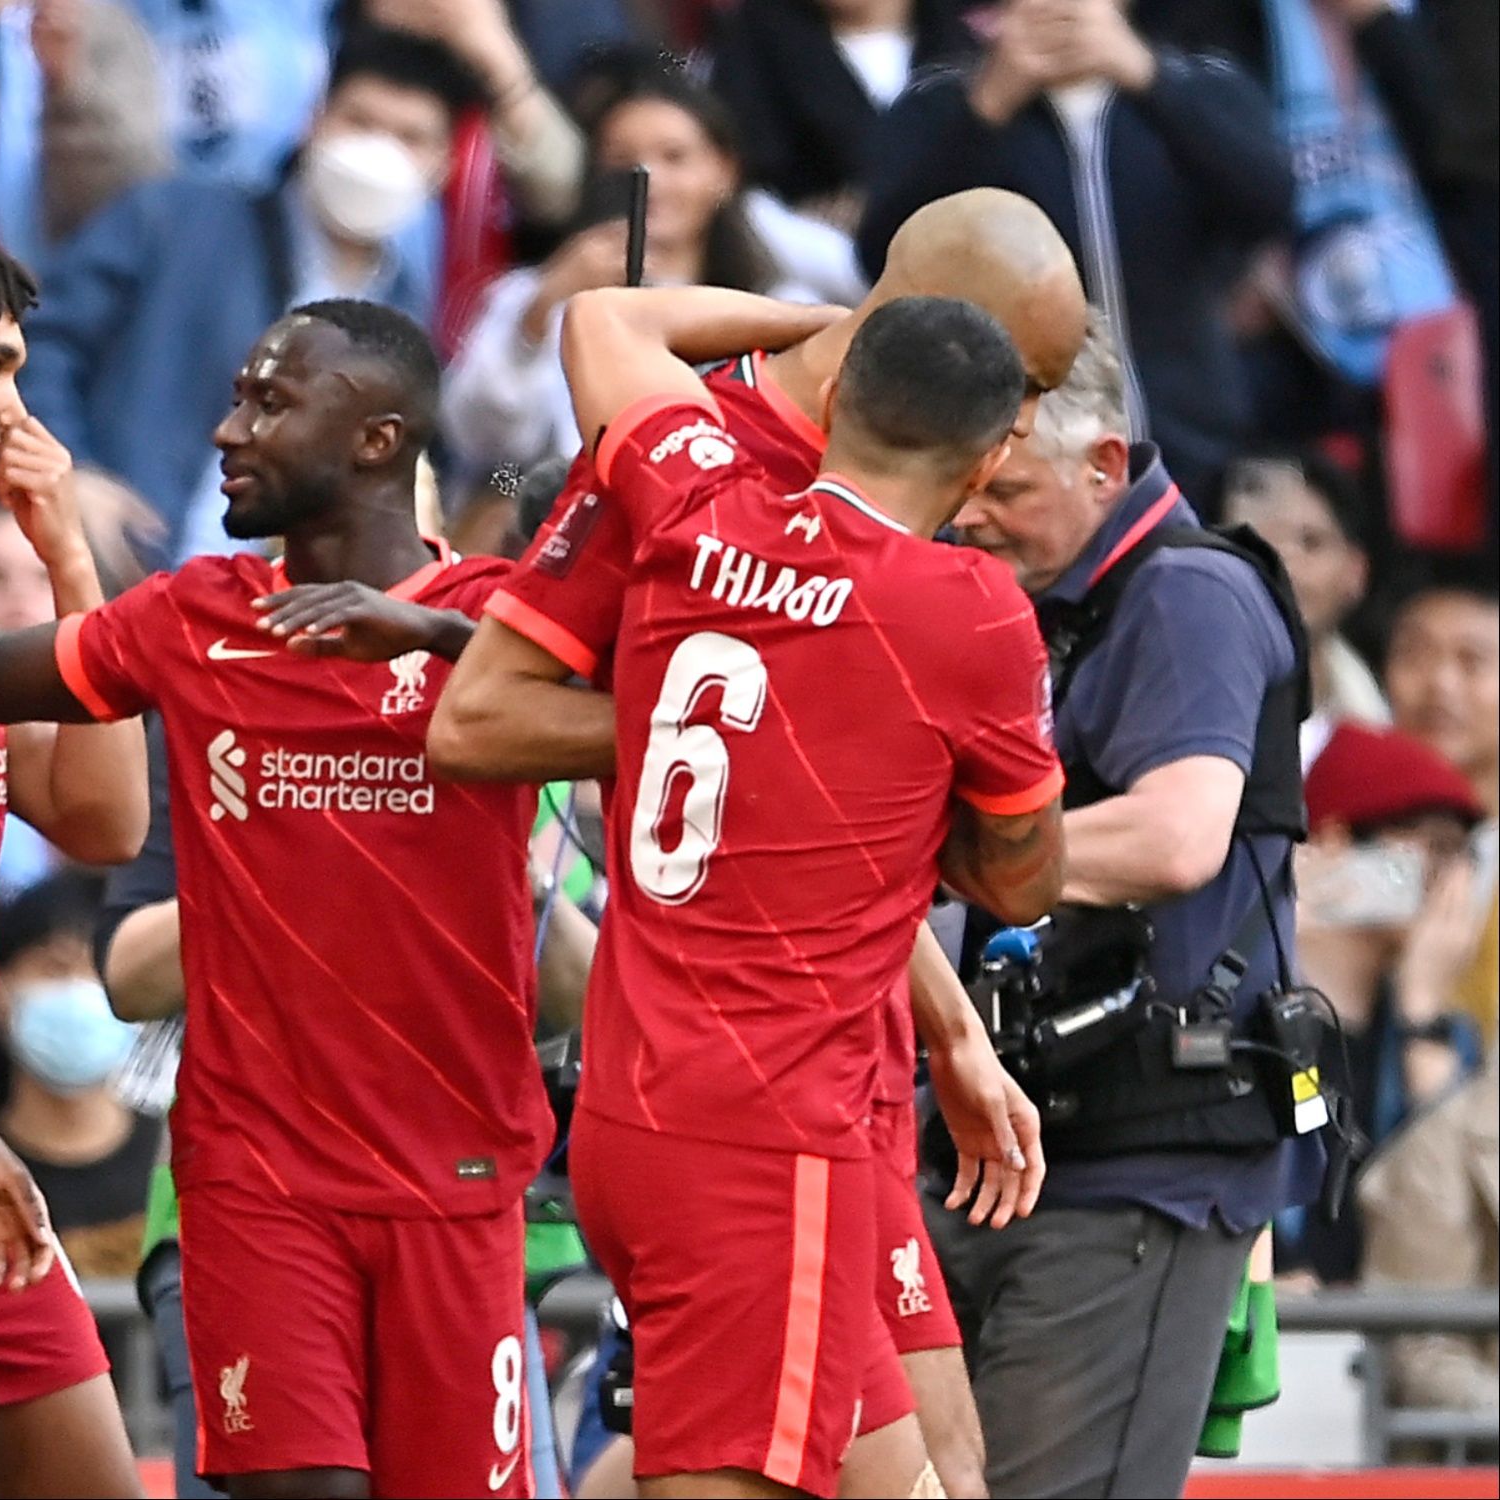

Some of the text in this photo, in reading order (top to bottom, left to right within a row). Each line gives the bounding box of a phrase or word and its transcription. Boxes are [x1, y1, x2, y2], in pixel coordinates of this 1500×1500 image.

[689, 533, 854, 627] THIAGO
[258, 778, 436, 815] chartered
[259, 746, 425, 782] standard
[629, 630, 768, 907] 6
[491, 1334, 523, 1455] 8
